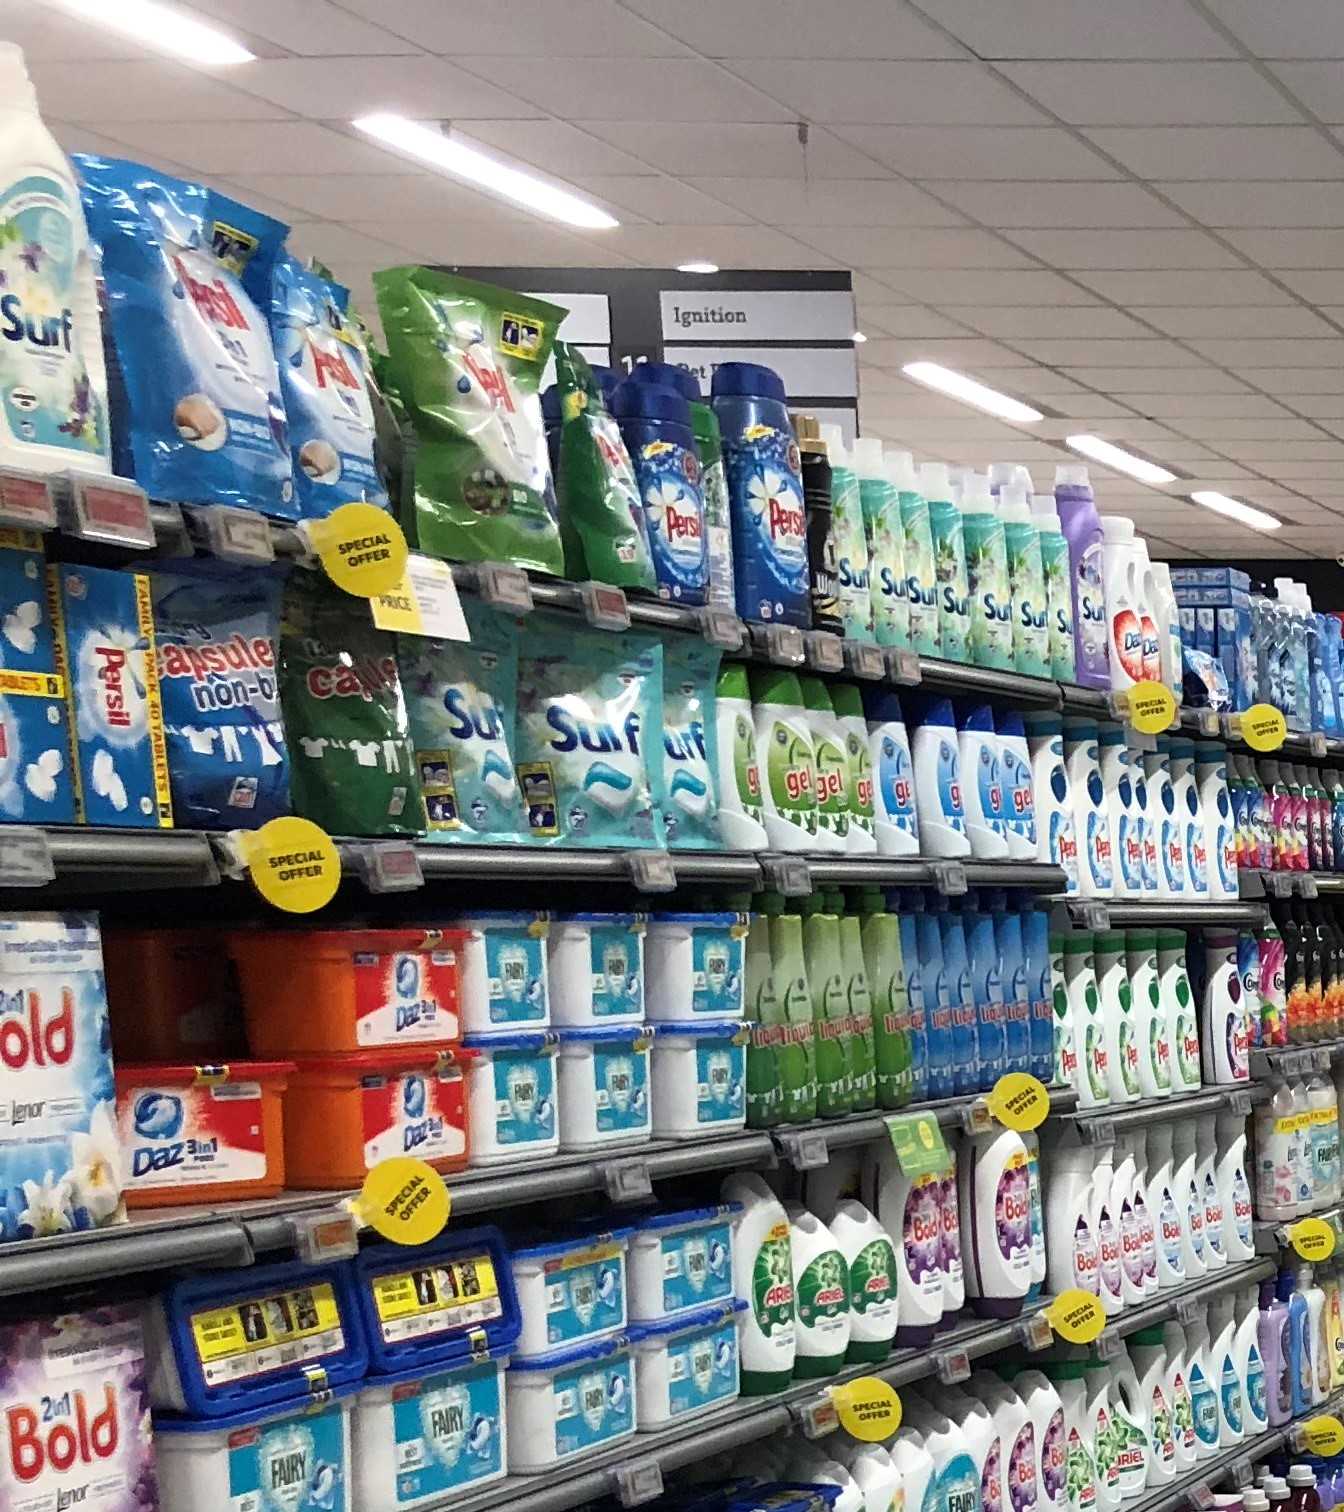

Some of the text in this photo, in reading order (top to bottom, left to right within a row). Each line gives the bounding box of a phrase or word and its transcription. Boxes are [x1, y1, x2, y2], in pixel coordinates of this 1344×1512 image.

[673, 307, 747, 327] Ignition
[2, 308, 72, 353] Surf
[339, 533, 391, 555] SPECIAL
[347, 549, 391, 567] OFFER
[379, 595, 412, 612] PRICE
[95, 647, 131, 727] Persil
[546, 705, 640, 756] Surf
[816, 768, 843, 801] gel
[269, 849, 325, 868] SPECIAL
[279, 865, 323, 882] OFFER
[1005, 1085, 1036, 1110] SPECIAL
[1014, 1094, 1039, 1115] OFFER
[133, 1141, 184, 1177] Daz
[385, 1174, 424, 1217] SPECIAL
[400, 1185, 432, 1222] OFFER
[914, 1216, 939, 1242] Bold
[1063, 1301, 1096, 1324] SPECIAL
[1071, 1312, 1096, 1331] OFFER
[853, 1400, 891, 1413] SPECIAL
[859, 1410, 891, 1421] OFFER
[6, 1380, 119, 1484] Bold
[432, 1404, 464, 1438] FAIRY
[271, 1450, 307, 1487] FAIRY
[57, 1482, 90, 1512] Lenor
